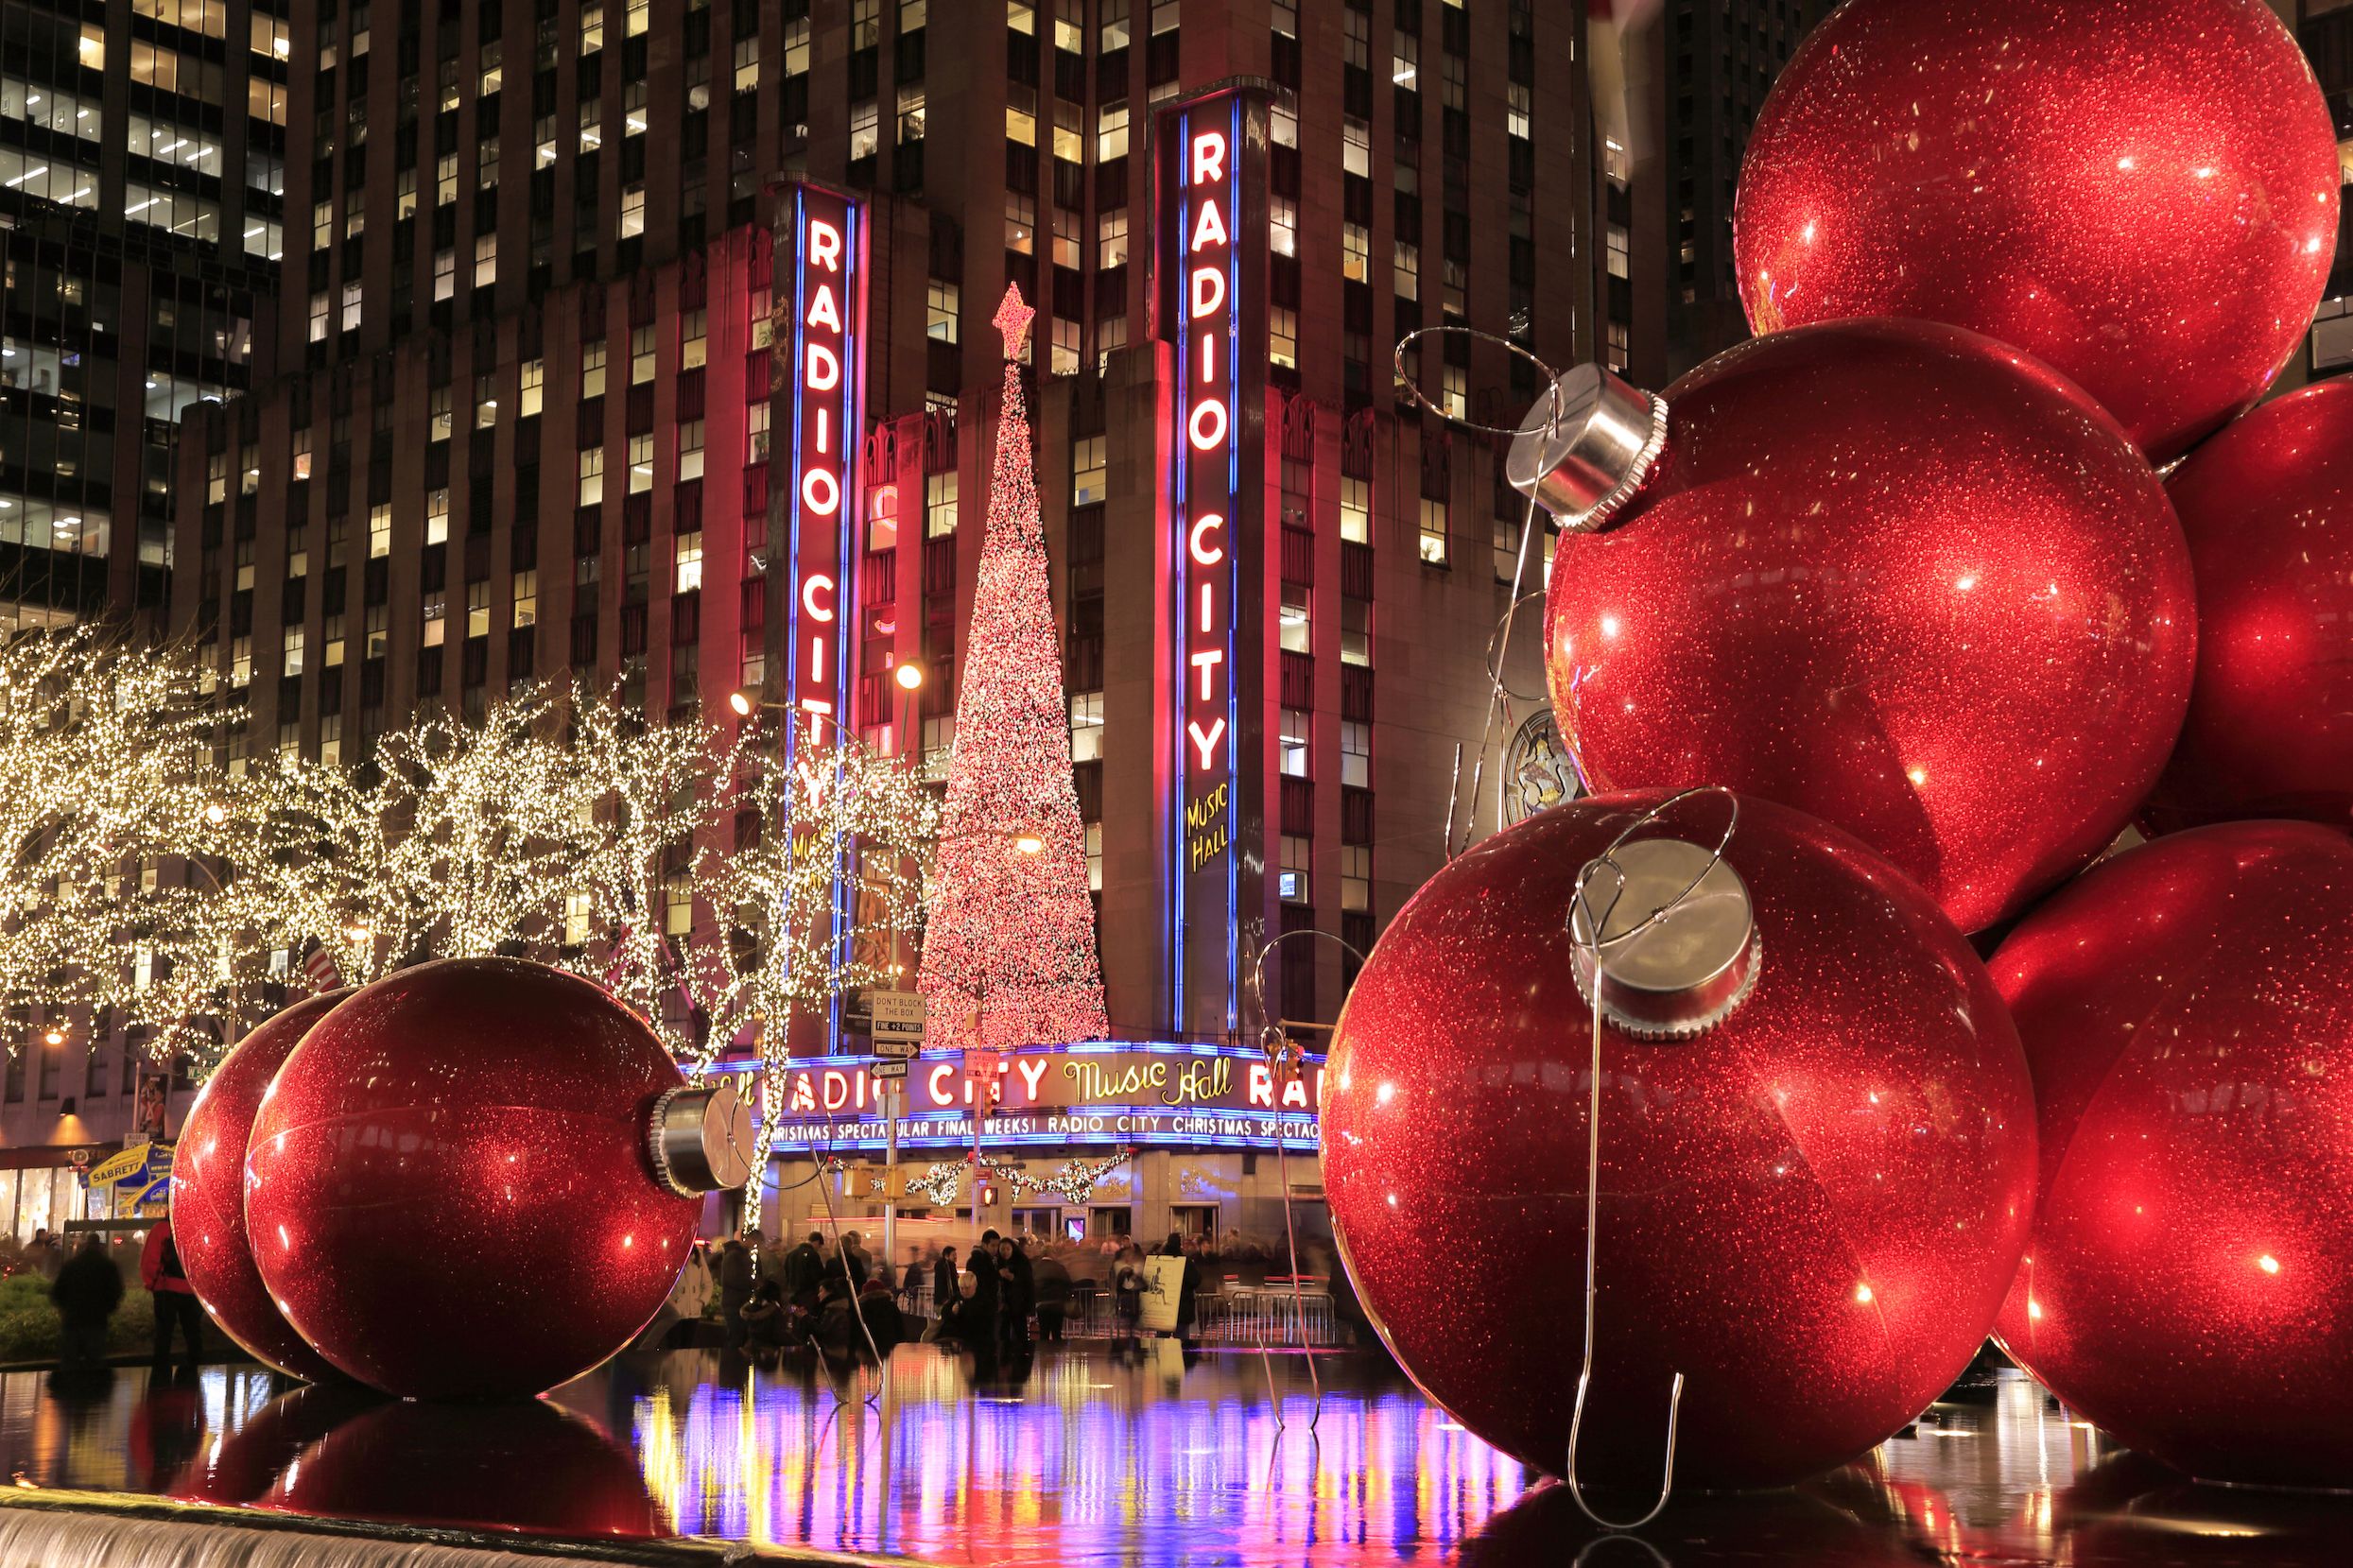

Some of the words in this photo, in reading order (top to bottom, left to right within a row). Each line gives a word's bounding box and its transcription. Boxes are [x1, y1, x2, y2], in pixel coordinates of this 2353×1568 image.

[1188, 132, 1228, 451] RADIO
[802, 218, 841, 516] RADIO
[1187, 513, 1226, 771] CITY
[1186, 783, 1228, 838] MUSIC
[1192, 823, 1228, 873] HALL
[885, 1008, 898, 1016] THE
[900, 1008, 914, 1017] BOX
[899, 998, 923, 1008] BLOCK
[876, 1022, 889, 1030] FINE
[891, 1023, 900, 1031] +2
[901, 1023, 921, 1032] POINTS
[900, 1045, 914, 1054] WAY
[875, 1066, 886, 1075] ONE
[1064, 1060, 1168, 1103] Music
[1161, 1056, 1234, 1106] Hall
[770, 1125, 830, 1142] HRISTMAS
[838, 1121, 930, 1140] SPECTAULAR
[937, 1119, 975, 1136] FINAL
[1047, 1115, 1104, 1133] RADIO
[1116, 1115, 1160, 1132] CITY
[1172, 1116, 1252, 1136] CHRISTMAS
[93, 1161, 141, 1183] SABRETT
